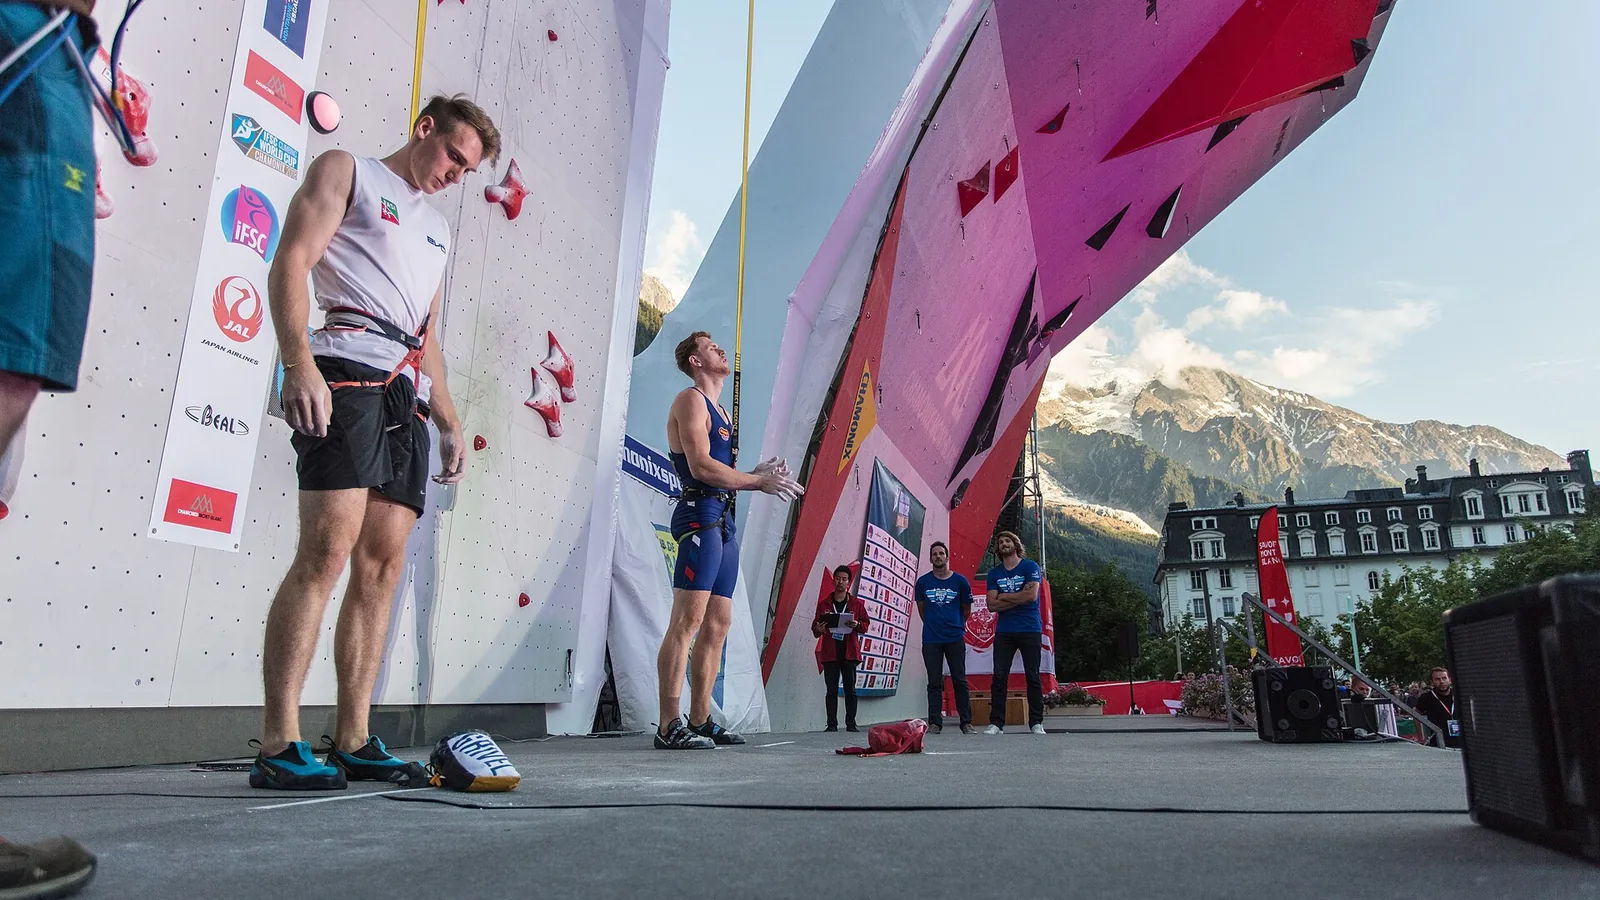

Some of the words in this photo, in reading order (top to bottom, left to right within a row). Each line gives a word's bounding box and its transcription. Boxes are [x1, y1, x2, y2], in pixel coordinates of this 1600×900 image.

[291, 0, 299, 23] ESCAL
[263, 131, 278, 147] IFSC
[254, 150, 285, 173] CHAMONIX
[260, 138, 284, 161] WORLD
[283, 152, 297, 168] CUP
[223, 320, 251, 339] JAL
[200, 339, 226, 352] JAPAN
[226, 349, 259, 366] AIRLINES
[843, 372, 870, 460] CHAMONIX
[451, 732, 513, 777] GRIVEL
